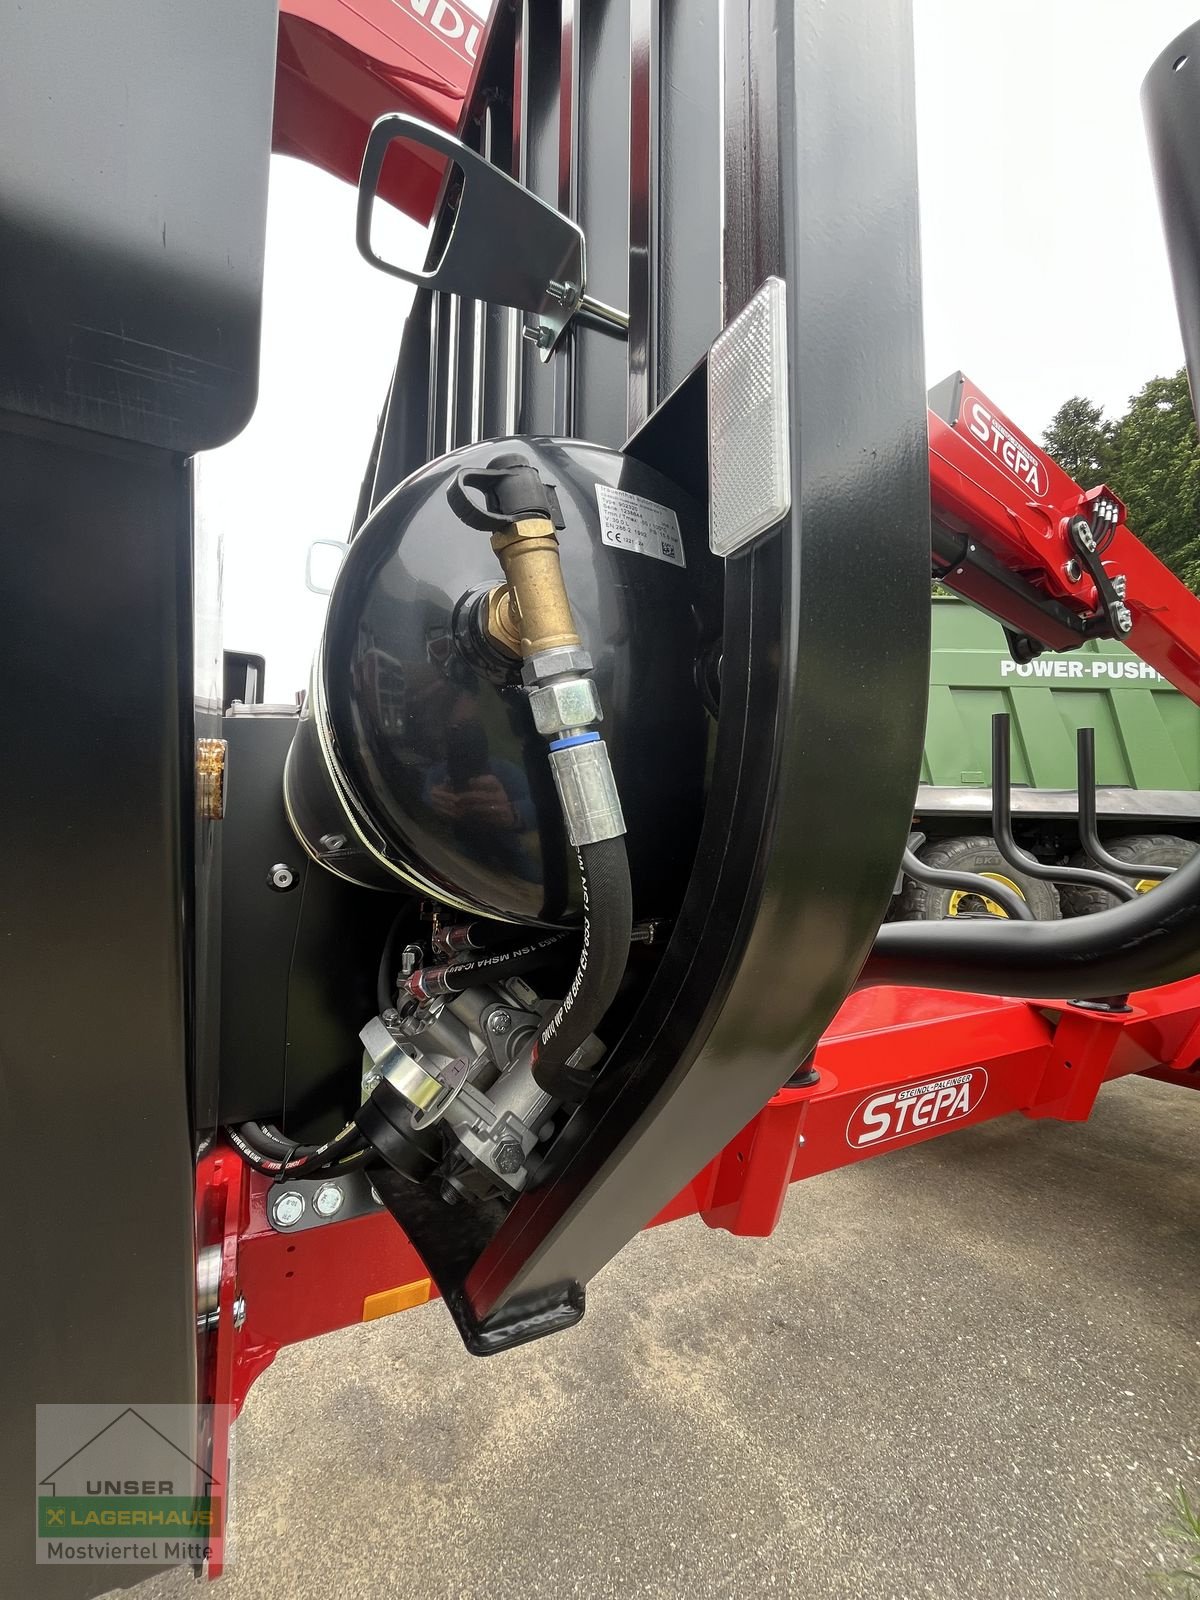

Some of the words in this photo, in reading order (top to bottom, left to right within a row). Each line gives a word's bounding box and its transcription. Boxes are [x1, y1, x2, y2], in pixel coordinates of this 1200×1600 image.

[970, 403, 1039, 493] STEPA
[478, 953, 510, 967] MSHA
[513, 945, 537, 957] 1SN
[571, 966, 584, 997] BAR
[900, 1074, 971, 1099] STEINDL-PALFINGER
[858, 1083, 970, 1144] STEPA
